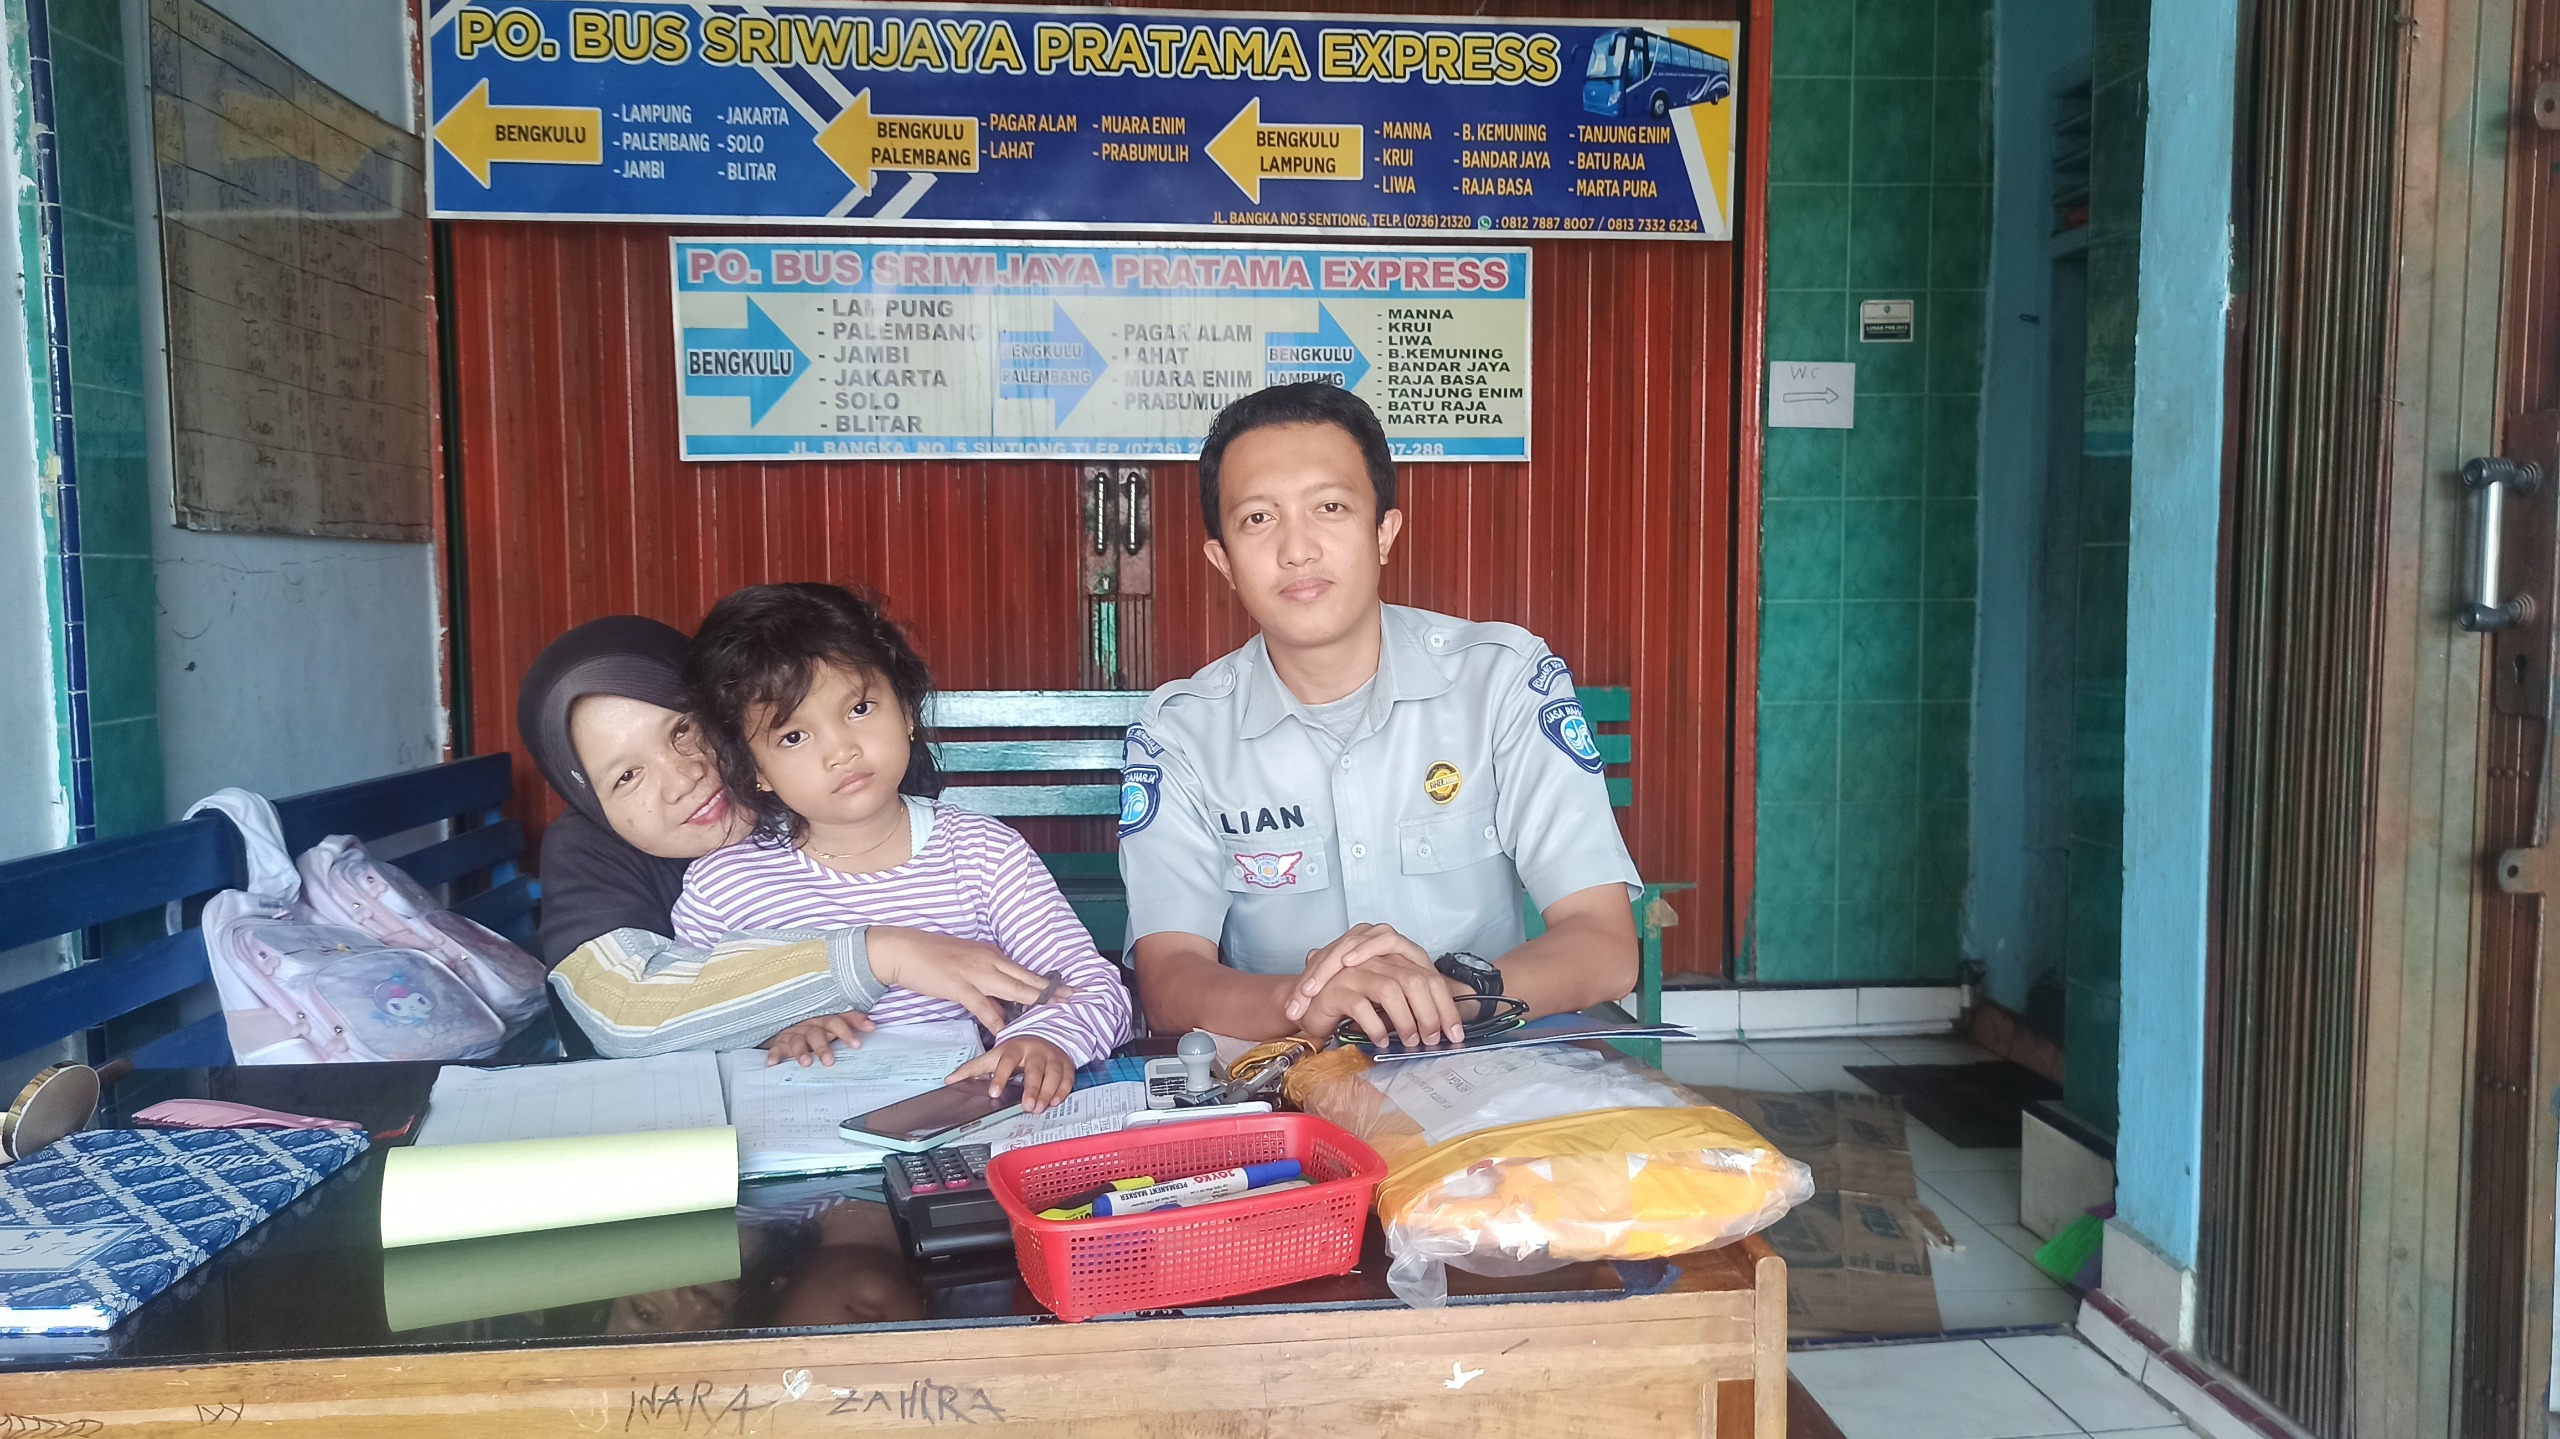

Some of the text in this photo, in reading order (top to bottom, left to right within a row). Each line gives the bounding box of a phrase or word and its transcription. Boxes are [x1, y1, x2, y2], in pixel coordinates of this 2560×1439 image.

[458, 9, 1558, 81] PO. BUS SRIWIJAYA PRATAMA EXPRESS
[621, 104, 790, 126] LAMPUNG JAKARTA
[989, 113, 1077, 133] PAGAR ALAM
[495, 124, 587, 144] BENGKULU
[876, 122, 965, 140] BENGKULU
[1101, 115, 1186, 135] MUARA ENIM
[1382, 121, 1433, 140] MANNA
[1462, 123, 1547, 142] B. KEMUNING
[622, 132, 765, 154] PALEMBANG SOLO
[1256, 130, 1341, 148] BENGKULU
[1577, 125, 1671, 144] TANJUNG ENIM
[871, 147, 971, 166] PALEMBANG
[990, 141, 1035, 160] LAHAT
[1101, 143, 1190, 163] PRABUMULIH
[1382, 148, 1414, 167] KRUI
[1260, 156, 1337, 174] LAMPUNG
[1462, 151, 1551, 169] BANDAR JAYA
[1577, 152, 1646, 171] BATU RAJA
[621, 160, 777, 182] JAMBI BLITAR
[1382, 175, 1417, 194] LIWA
[1462, 177, 1534, 196] RAJA BASA
[1576, 179, 1658, 198] MARTA PURA
[1212, 210, 1228, 225] JL.
[1229, 211, 1279, 226] BANGKA
[1280, 212, 1298, 226] NO
[1299, 212, 1306, 226] 5
[1371, 213, 1402, 228] TELP.
[1403, 213, 1439, 229] (0736)
[1440, 214, 1472, 229] 21320
[1531, 217, 1561, 230] 7887
[1563, 217, 1596, 230] 8007
[1607, 217, 1635, 231] 0813
[1637, 218, 1667, 232] 7332
[1668, 219, 1699, 233] 6234
[689, 251, 1509, 291] PO. BUS SRIWIJAYA PRATAMA EXPRESS
[1388, 309, 1454, 319] MANNA
[1199, 325, 1252, 342] ALAM
[1388, 322, 1432, 333] KRUI
[1388, 335, 1433, 346] LIWA
[688, 350, 793, 376] BENGKULU
[833, 346, 910, 364] JAMBI
[1269, 347, 1354, 362] BENGKULU
[1388, 362, 1511, 372] BANDAR JAYA
[834, 369, 948, 387] JAKARTA
[1003, 369, 1091, 384] PALEMBANG
[1124, 370, 1252, 388] MUARA ENIM
[1388, 375, 1488, 385] RAJA BASA
[835, 392, 900, 411] SOLO
[1388, 388, 1523, 399] TANJUNG ENIM
[1388, 401, 1487, 412] BATU RAJA
[836, 415, 924, 433] BLITAR
[1388, 414, 1503, 424] MARTA PURA
[1545, 708, 1566, 724] JASA
[1220, 804, 1305, 835] LIAN
[1193, 1169, 1236, 1184] JOYKO
[1119, 1190, 1149, 1201] MARKER
[1149, 1181, 1189, 1196] PERMANENT
